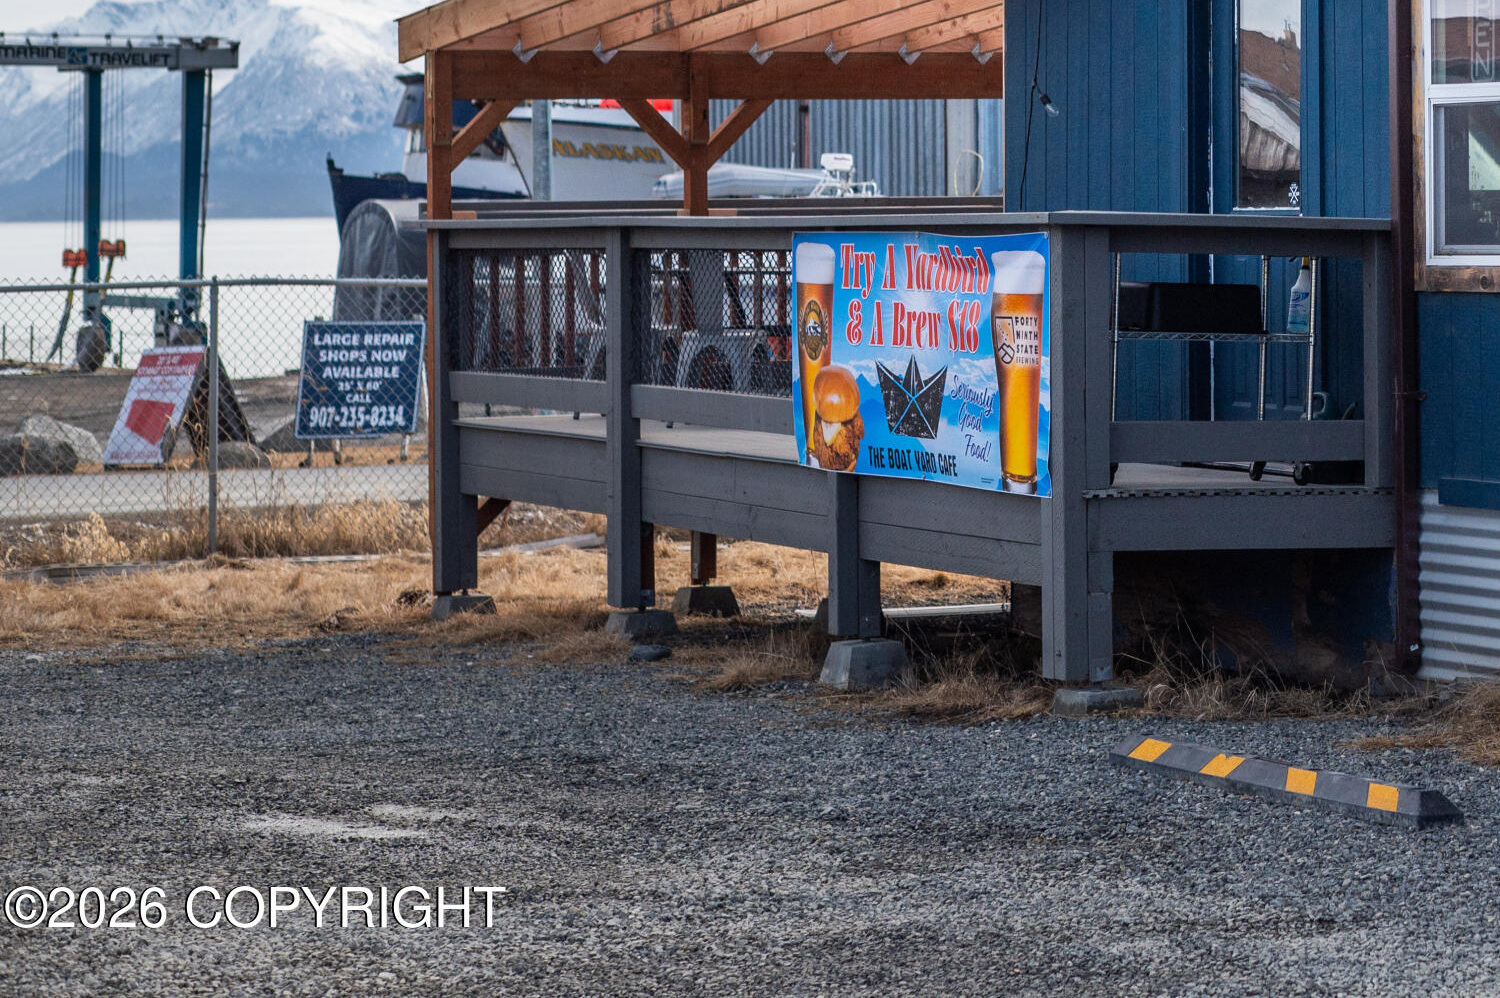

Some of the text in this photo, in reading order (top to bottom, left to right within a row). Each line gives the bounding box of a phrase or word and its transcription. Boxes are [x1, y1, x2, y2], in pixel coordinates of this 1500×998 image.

[89, 52, 171, 67] TRAVELIFT
[840, 243, 990, 299] Try A Yardbird
[846, 298, 862, 345] &
[869, 300, 884, 346] A
[891, 300, 940, 348] Brew
[947, 294, 981, 355] $18
[1015, 316, 1038, 326] FORTY
[314, 333, 415, 346] LARGE REPAIR
[1015, 330, 1038, 341] NINTH
[319, 349, 407, 362] SHOPS NOW
[1016, 344, 1039, 354] STATE
[323, 366, 400, 379] AVAILABLE
[346, 393, 372, 403] CALL
[950, 374, 993, 416] Seriously
[310, 405, 406, 427] 907-235-8234
[959, 402, 982, 432] Good
[965, 434, 991, 462] Food!
[868, 445, 958, 477] THE BOAT YARD CAFE
